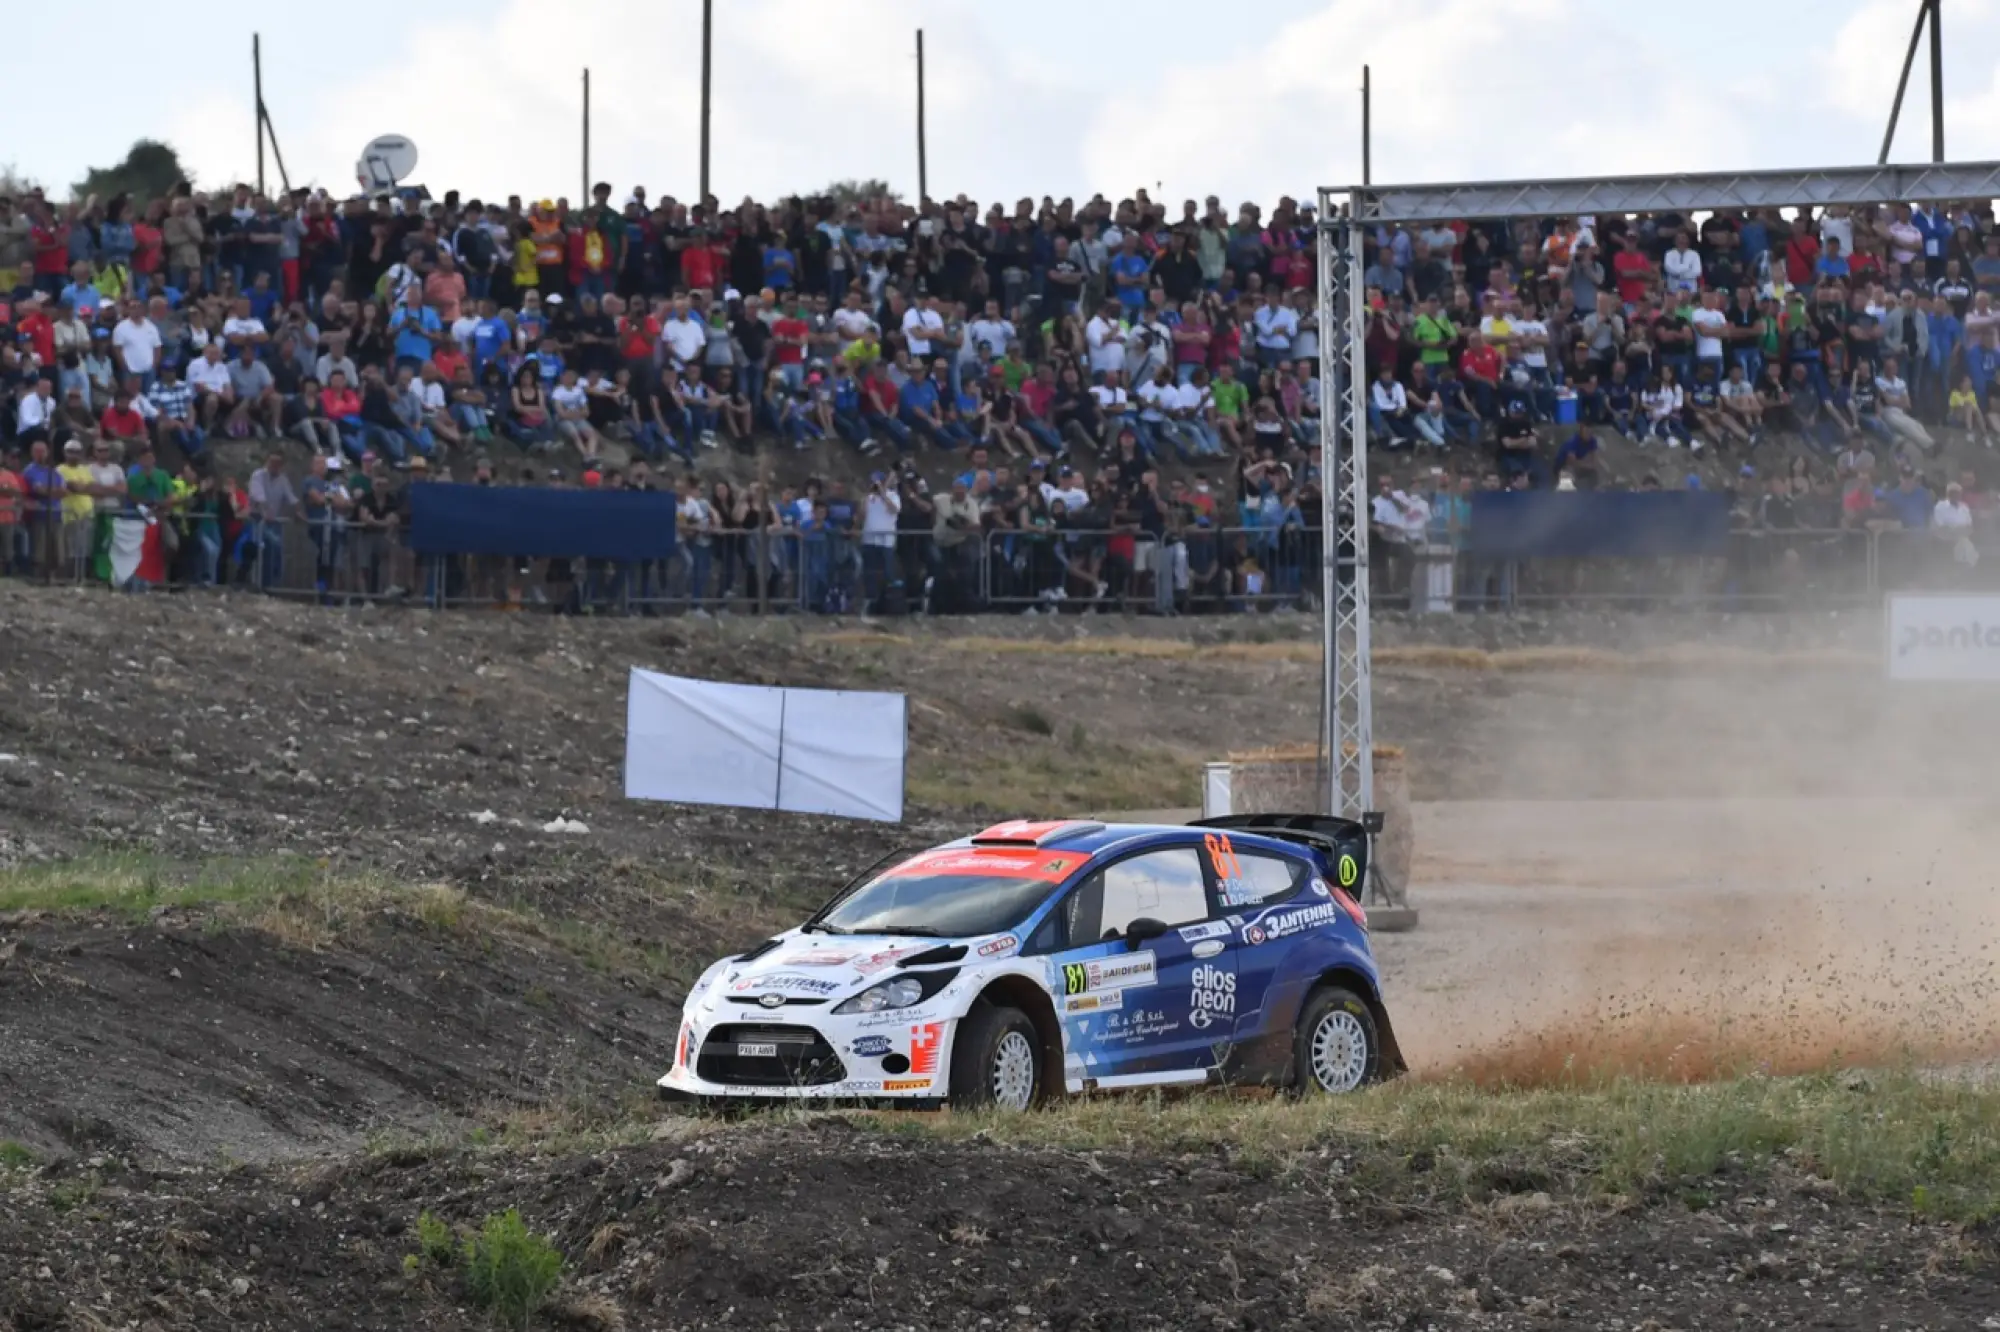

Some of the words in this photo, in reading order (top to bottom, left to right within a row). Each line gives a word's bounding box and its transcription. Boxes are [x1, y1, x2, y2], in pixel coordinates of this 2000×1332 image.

[1204, 833, 1242, 879] 81
[1066, 963, 1084, 994] 81
[1192, 964, 1236, 992] elios
[1191, 988, 1235, 1012] neon
